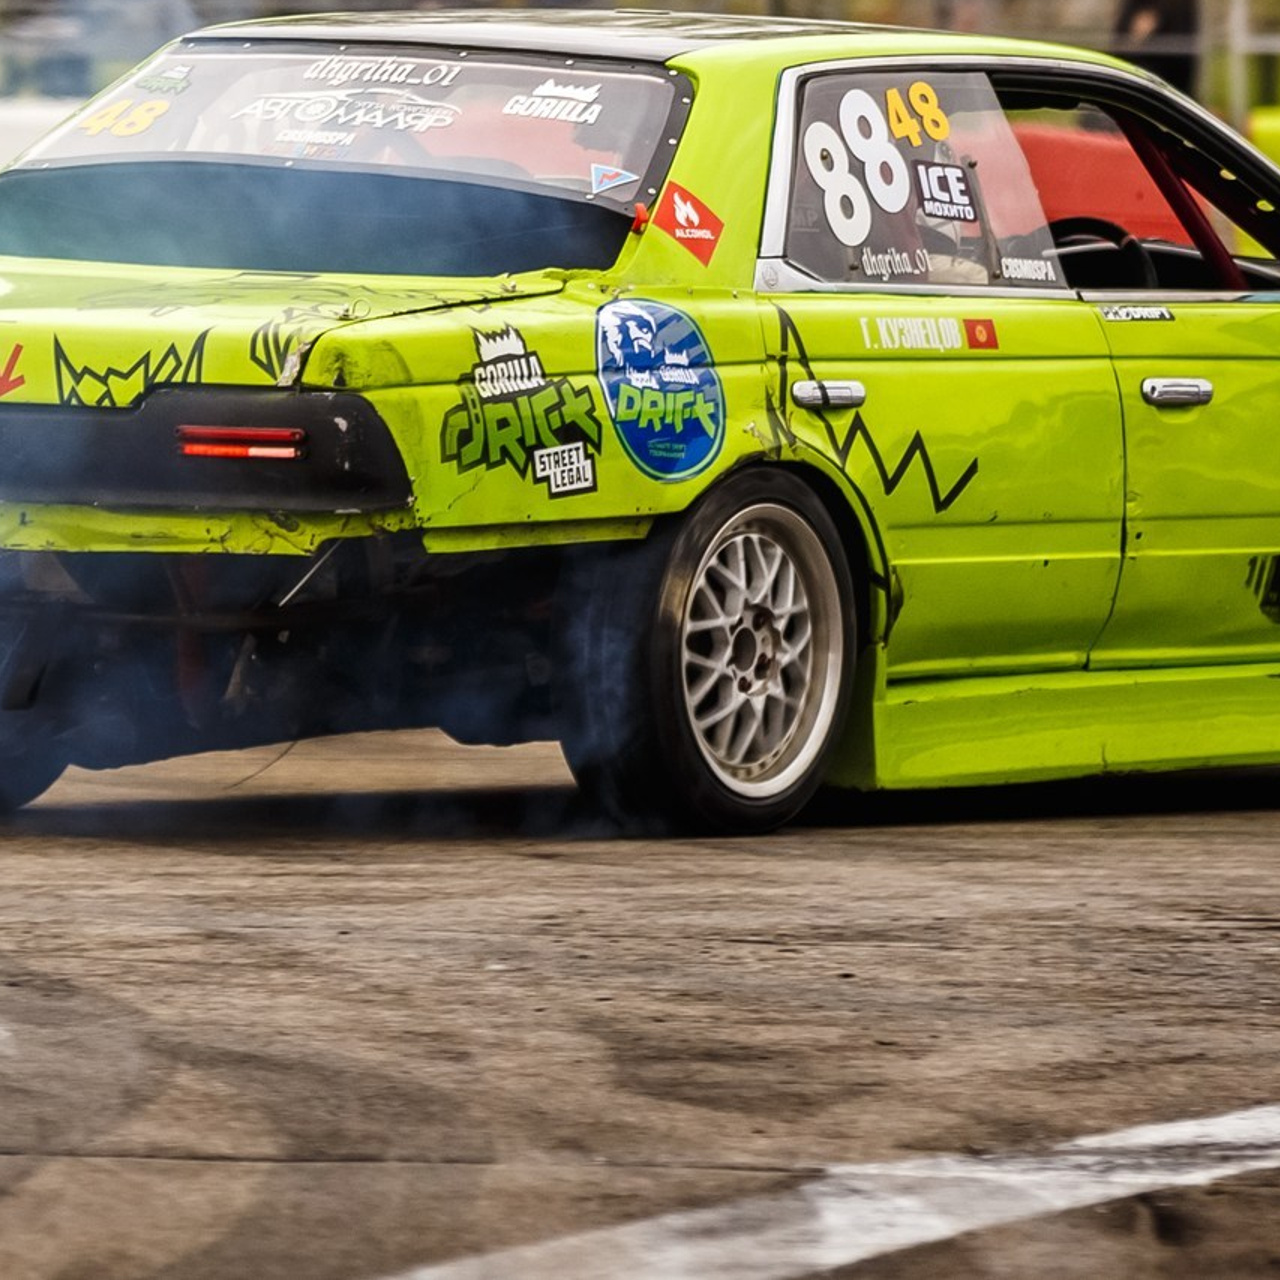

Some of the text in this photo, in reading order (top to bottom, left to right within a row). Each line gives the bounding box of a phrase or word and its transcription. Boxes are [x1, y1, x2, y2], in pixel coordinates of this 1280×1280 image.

[78, 99, 171, 137] 48
[503, 95, 603, 125] GORILLA
[885, 81, 951, 147] 48
[803, 88, 910, 247] 88
[916, 164, 971, 205] ICE
[675, 228, 716, 241] ALCOHOL
[875, 317, 963, 353] КУЗНЕЦОВ
[474, 355, 546, 398] GORILLA
[659, 365, 700, 386] GORILLA
[615, 383, 716, 440] DRIFT
[538, 446, 582, 472] STREET
[553, 465, 590, 489] LEGAL
